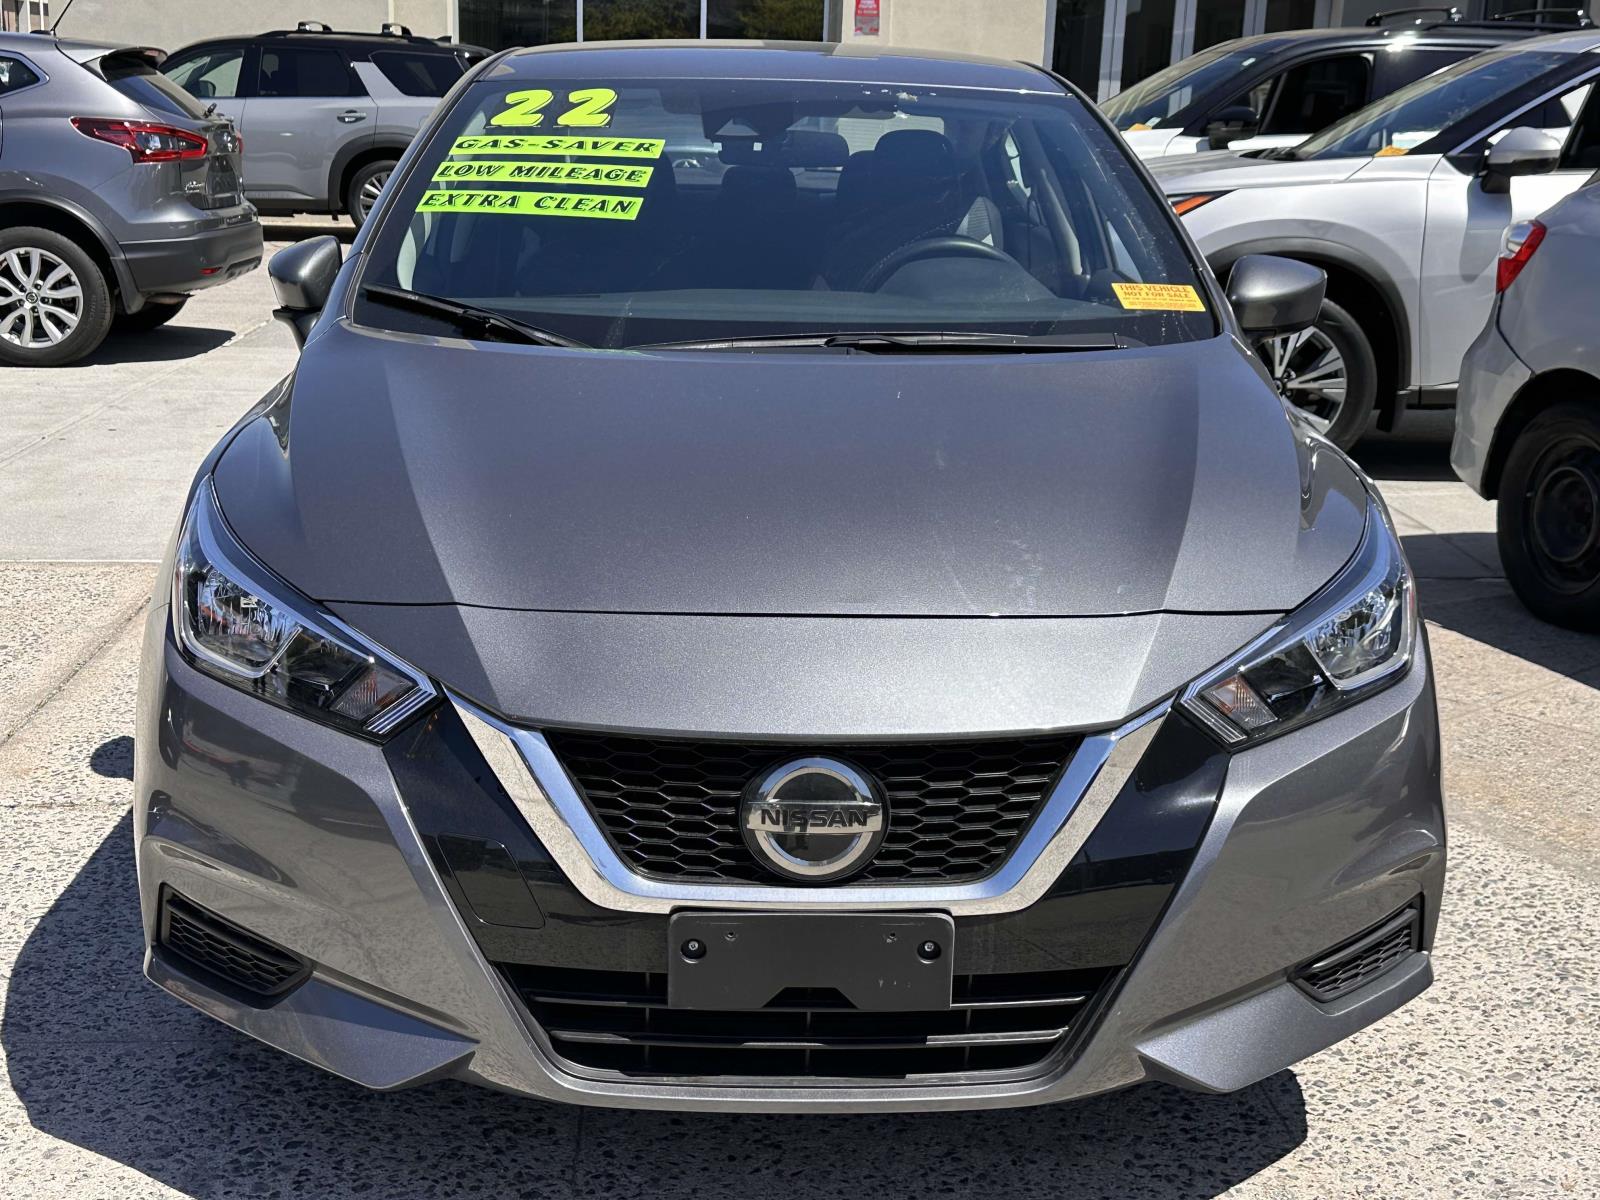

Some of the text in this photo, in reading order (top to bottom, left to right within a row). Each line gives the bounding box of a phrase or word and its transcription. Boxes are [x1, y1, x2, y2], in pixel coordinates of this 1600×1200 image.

[455, 138, 655, 153] GAS-SAVER
[437, 164, 645, 182] LOW MILEAGE
[422, 193, 634, 214] EXTRA CLEAN
[1145, 285, 1190, 293] VEHICLE
[761, 808, 868, 827] NISSAN
